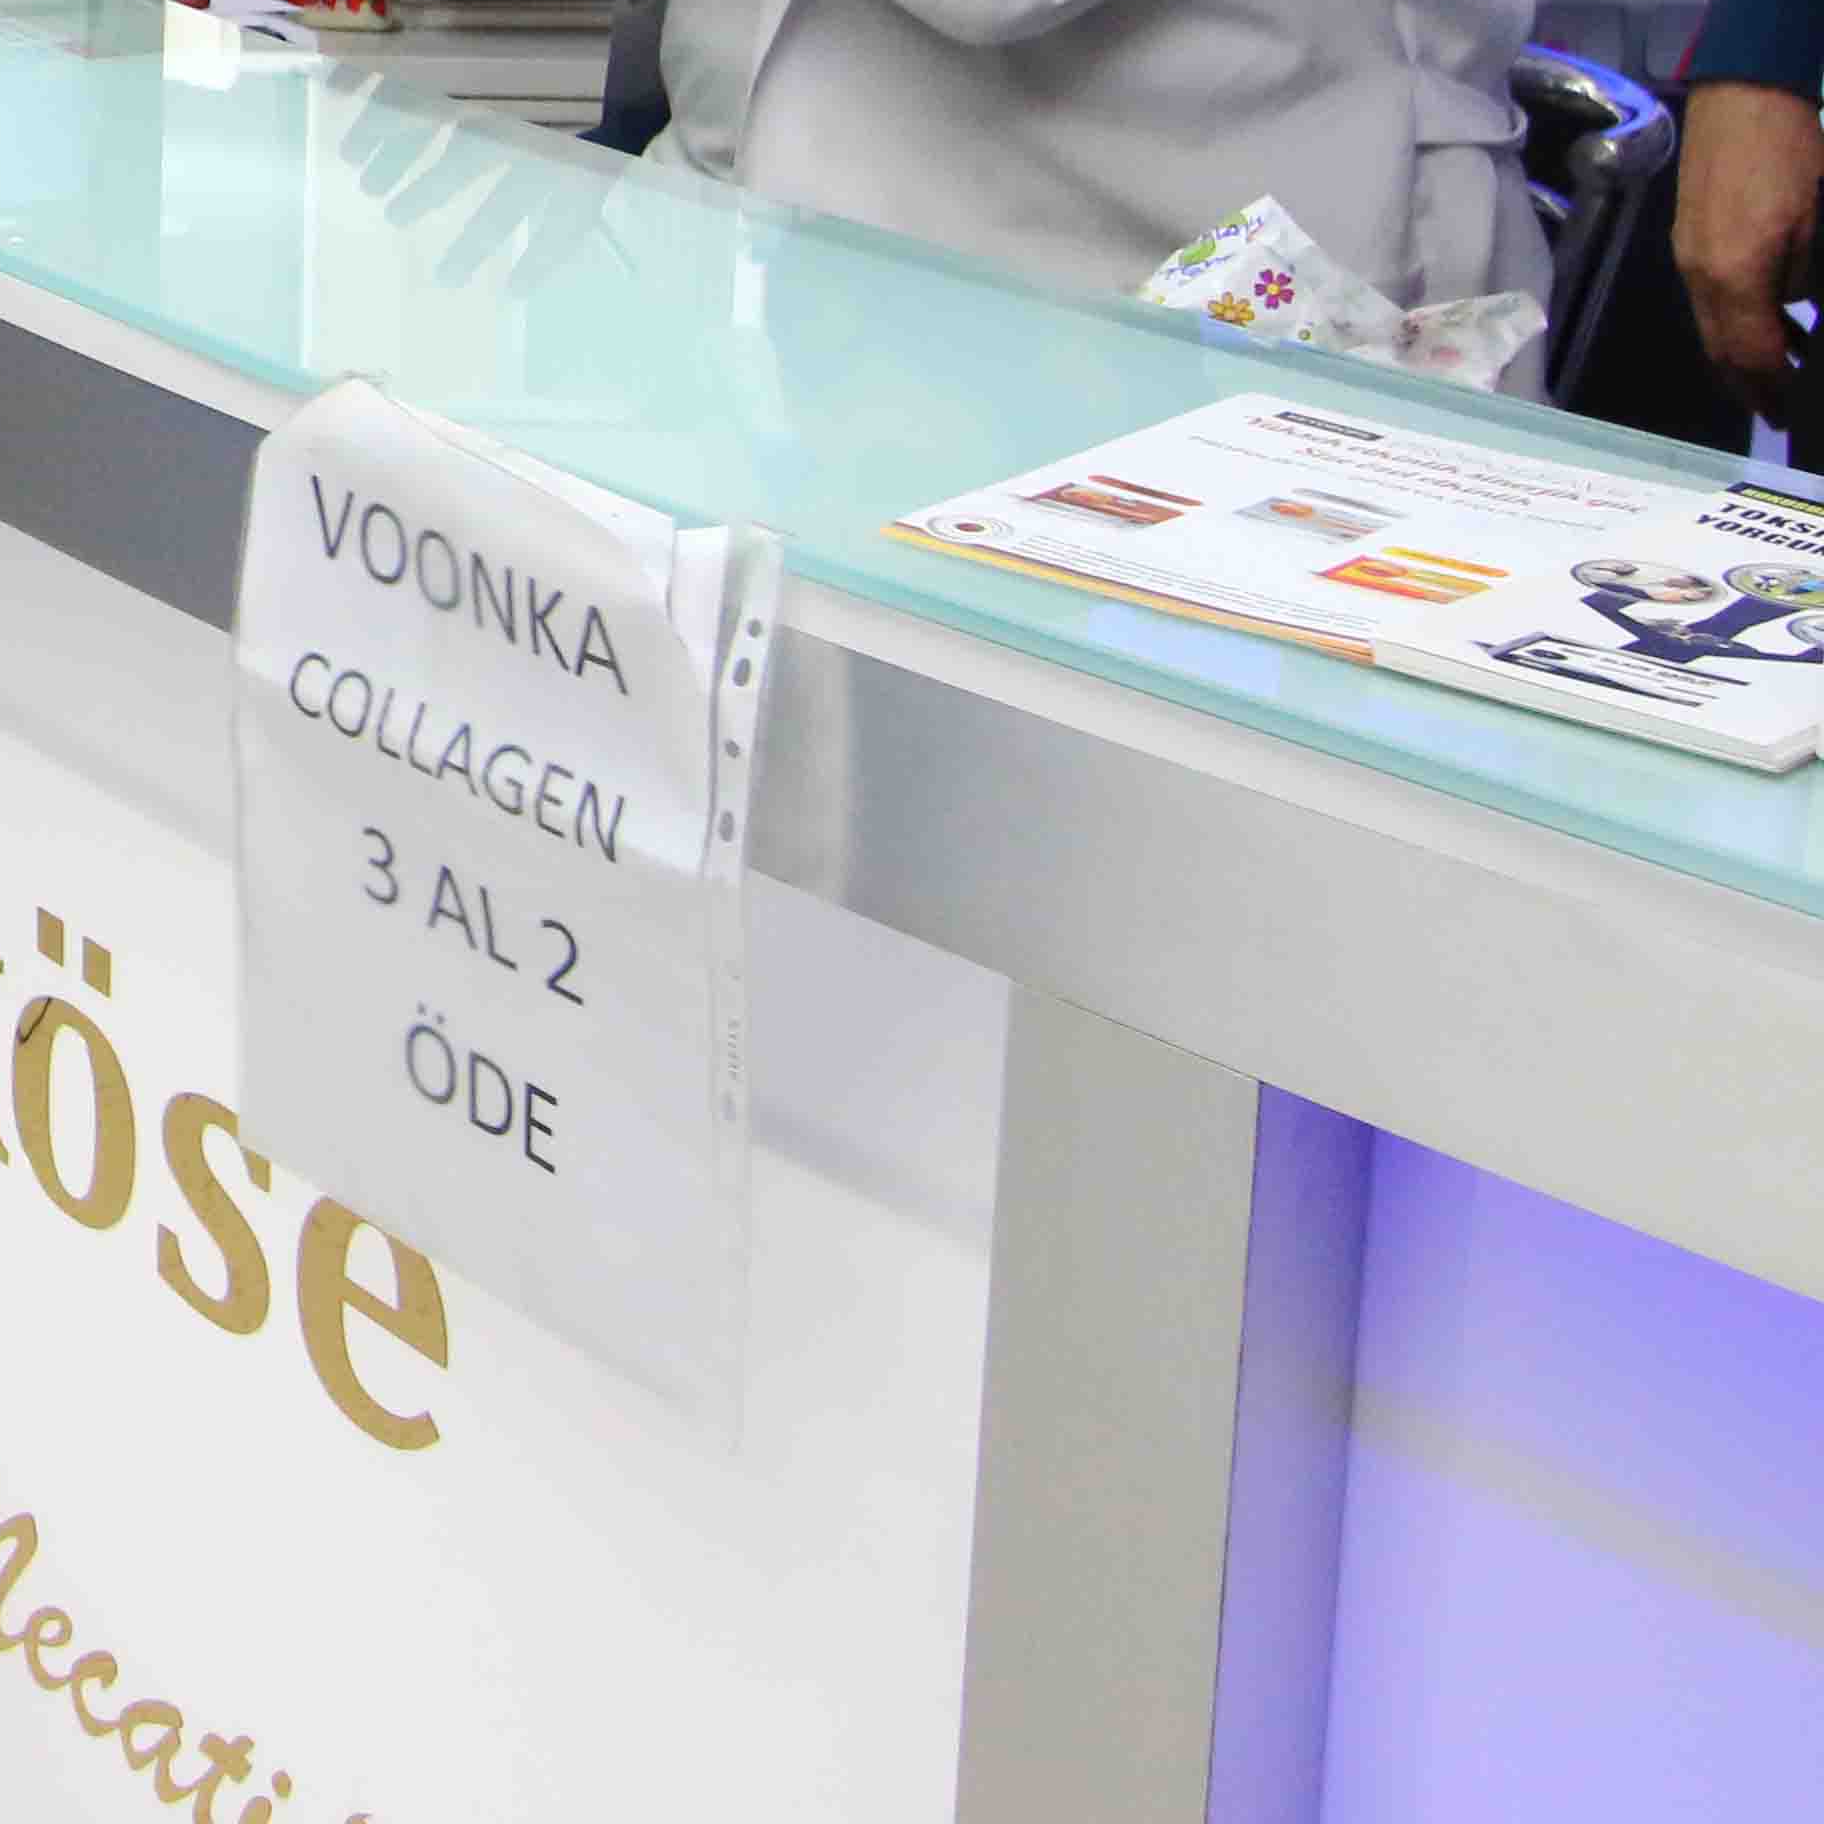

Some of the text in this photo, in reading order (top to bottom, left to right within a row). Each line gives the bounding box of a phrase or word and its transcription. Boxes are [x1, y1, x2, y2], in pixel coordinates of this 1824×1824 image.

[308, 473, 630, 696] VOONKA
[287, 650, 627, 864] COLLAGEN
[361, 827, 585, 1007] 3 AL 2
[403, 1001, 560, 1175] ÖDE
